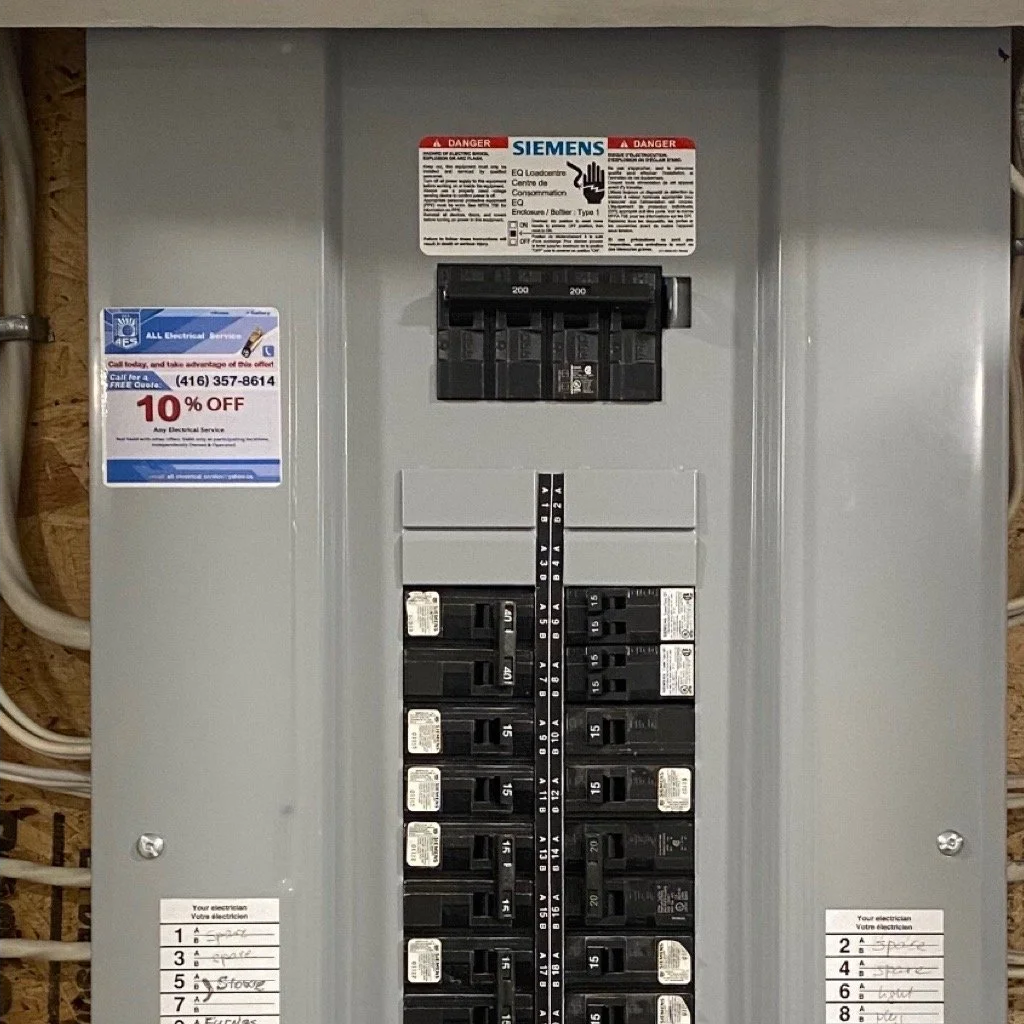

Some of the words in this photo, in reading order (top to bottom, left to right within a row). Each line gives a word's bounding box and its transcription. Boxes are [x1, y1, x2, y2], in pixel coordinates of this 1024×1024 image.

[448, 139, 491, 148] DANGER
[512, 140, 605, 156] SIEMENS
[633, 139, 677, 148] DANGER
[511, 169, 524, 177] EQ
[525, 169, 566, 177] Loadcentre
[511, 179, 536, 187] Centre
[538, 179, 548, 187] de
[511, 208, 545, 216] Enclosure
[577, 208, 594, 217] Type
[512, 286, 529, 294] 200
[569, 287, 587, 295] 200
[146, 331, 163, 340] ALL
[164, 331, 205, 340] Electrical
[209, 331, 243, 340] Service
[185, 361, 227, 369] advantage
[109, 373, 126, 381] Call
[127, 373, 140, 381] for
[175, 374, 209, 387] (416)
[213, 375, 275, 387] 357-8614
[109, 381, 132, 389] FREE
[136, 394, 181, 422] 10
[184, 396, 202, 411] %
[207, 397, 245, 411] OFF
[591, 654, 598, 666] 15
[503, 667, 513, 680] 40
[502, 724, 513, 738] 15
[590, 724, 600, 738] 15
[502, 783, 513, 797] 15
[590, 782, 601, 795] 15
[502, 840, 511, 854] 15
[502, 899, 510, 912] 15
[174, 928, 182, 943] 1
[839, 937, 850, 954] 2
[174, 950, 185, 966] 3
[501, 957, 511, 970] 15
[589, 955, 599, 969] 15
[838, 960, 850, 976] 4
[174, 973, 185, 989] 5
[839, 983, 850, 999] 6
[174, 996, 186, 1012] 7
[839, 1005, 851, 1022] 8
